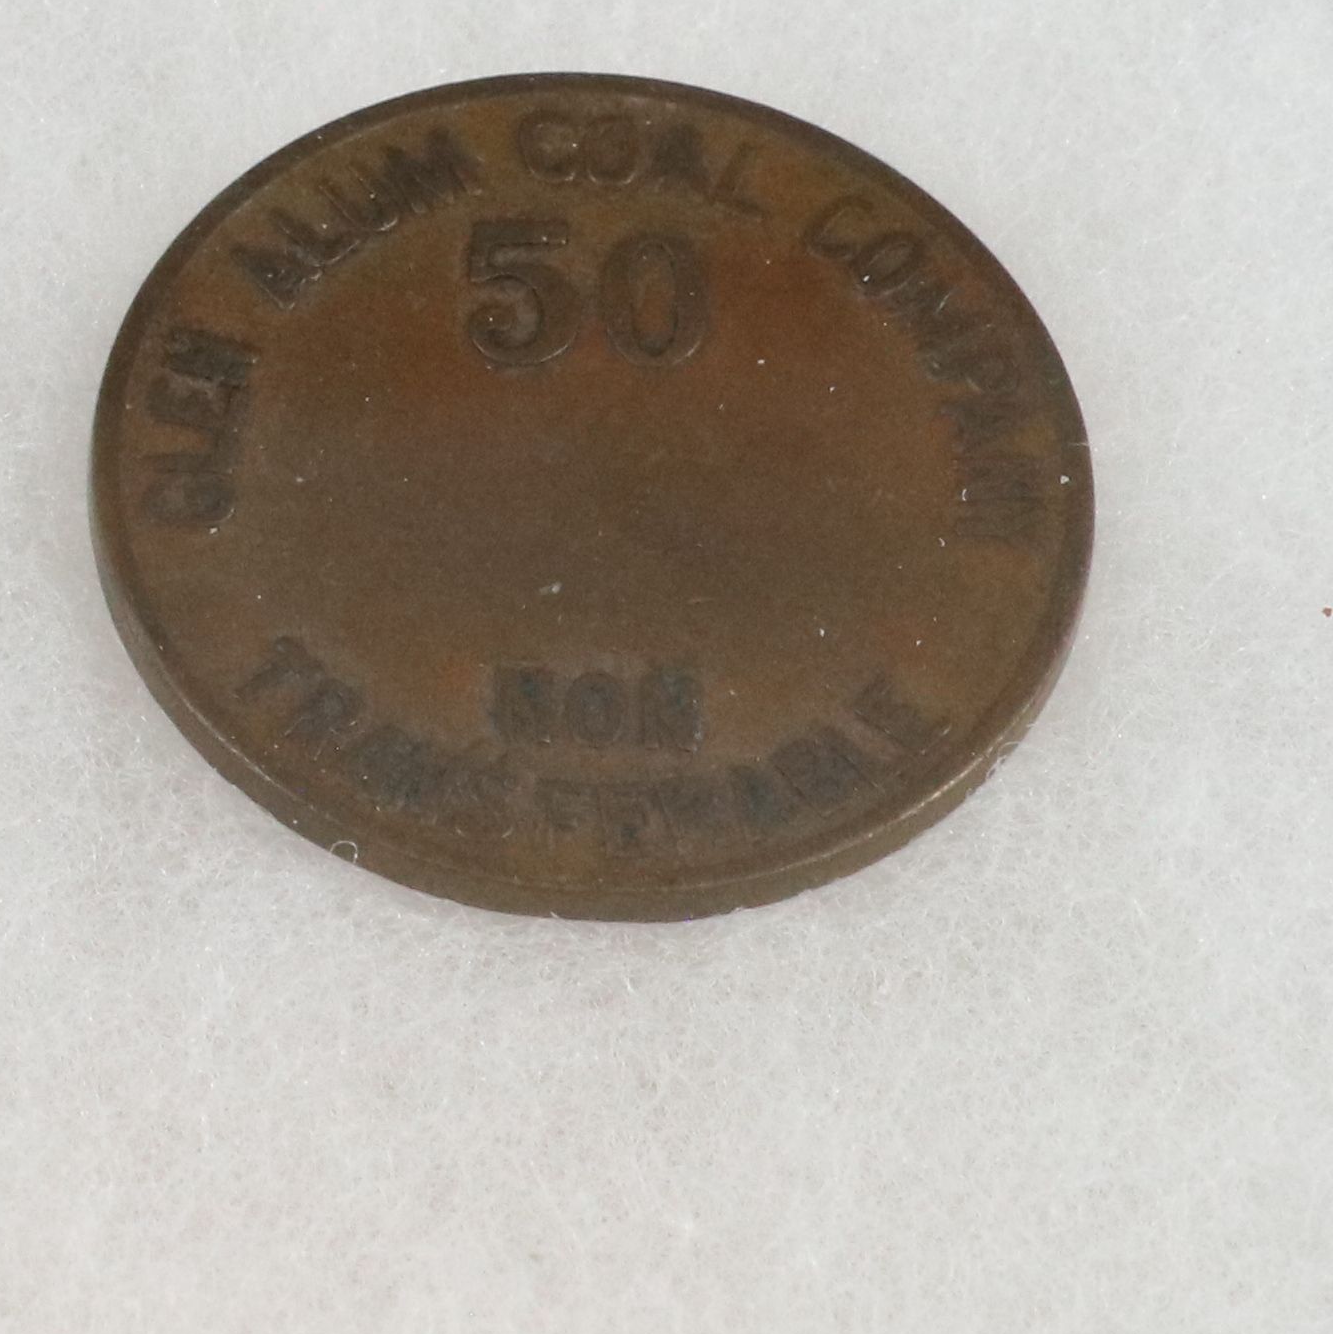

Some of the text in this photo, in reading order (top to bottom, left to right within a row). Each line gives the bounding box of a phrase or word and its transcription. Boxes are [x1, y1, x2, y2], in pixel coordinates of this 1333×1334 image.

[229, 123, 485, 313] ALUM
[515, 107, 770, 223] COAL
[465, 215, 713, 373] 50
